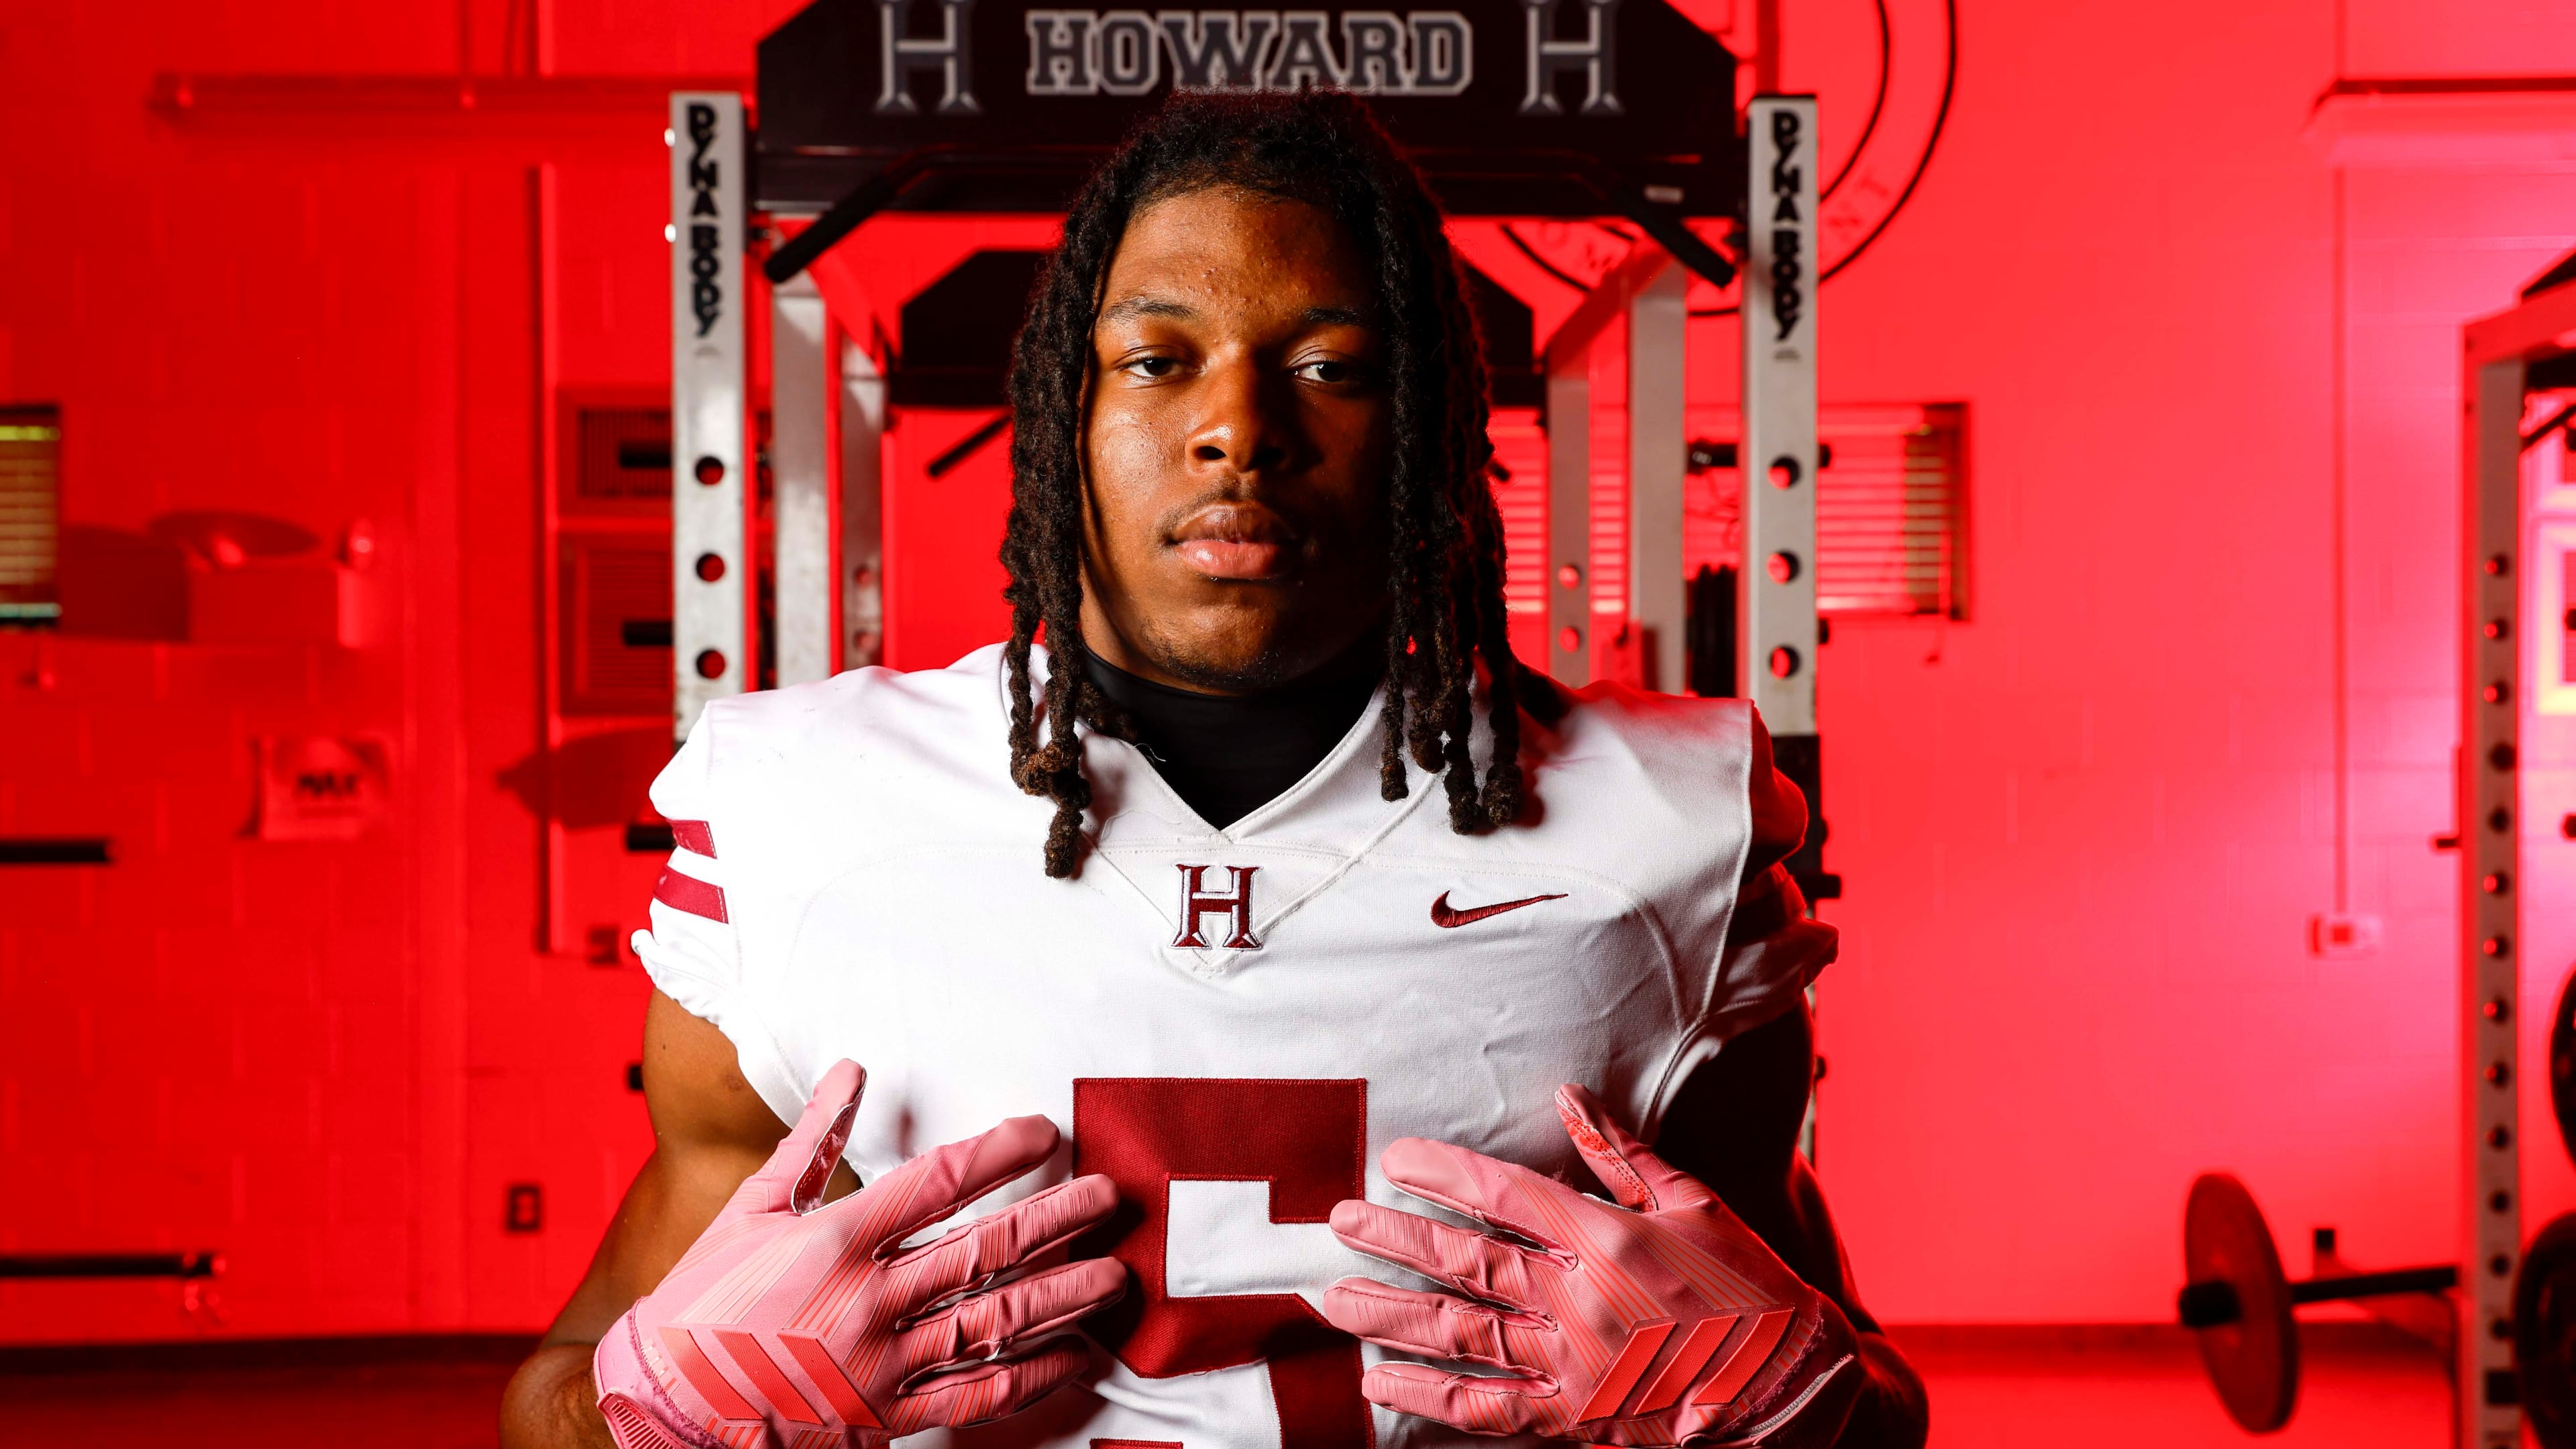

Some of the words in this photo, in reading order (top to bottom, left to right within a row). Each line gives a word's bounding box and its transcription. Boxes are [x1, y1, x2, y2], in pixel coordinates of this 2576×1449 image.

[873, 0, 981, 113] H
[1026, 11, 1472, 94] HOWARD
[1518, 0, 1626, 116] H
[1170, 861, 1265, 950] H
[1071, 1077, 1375, 1449] 5
